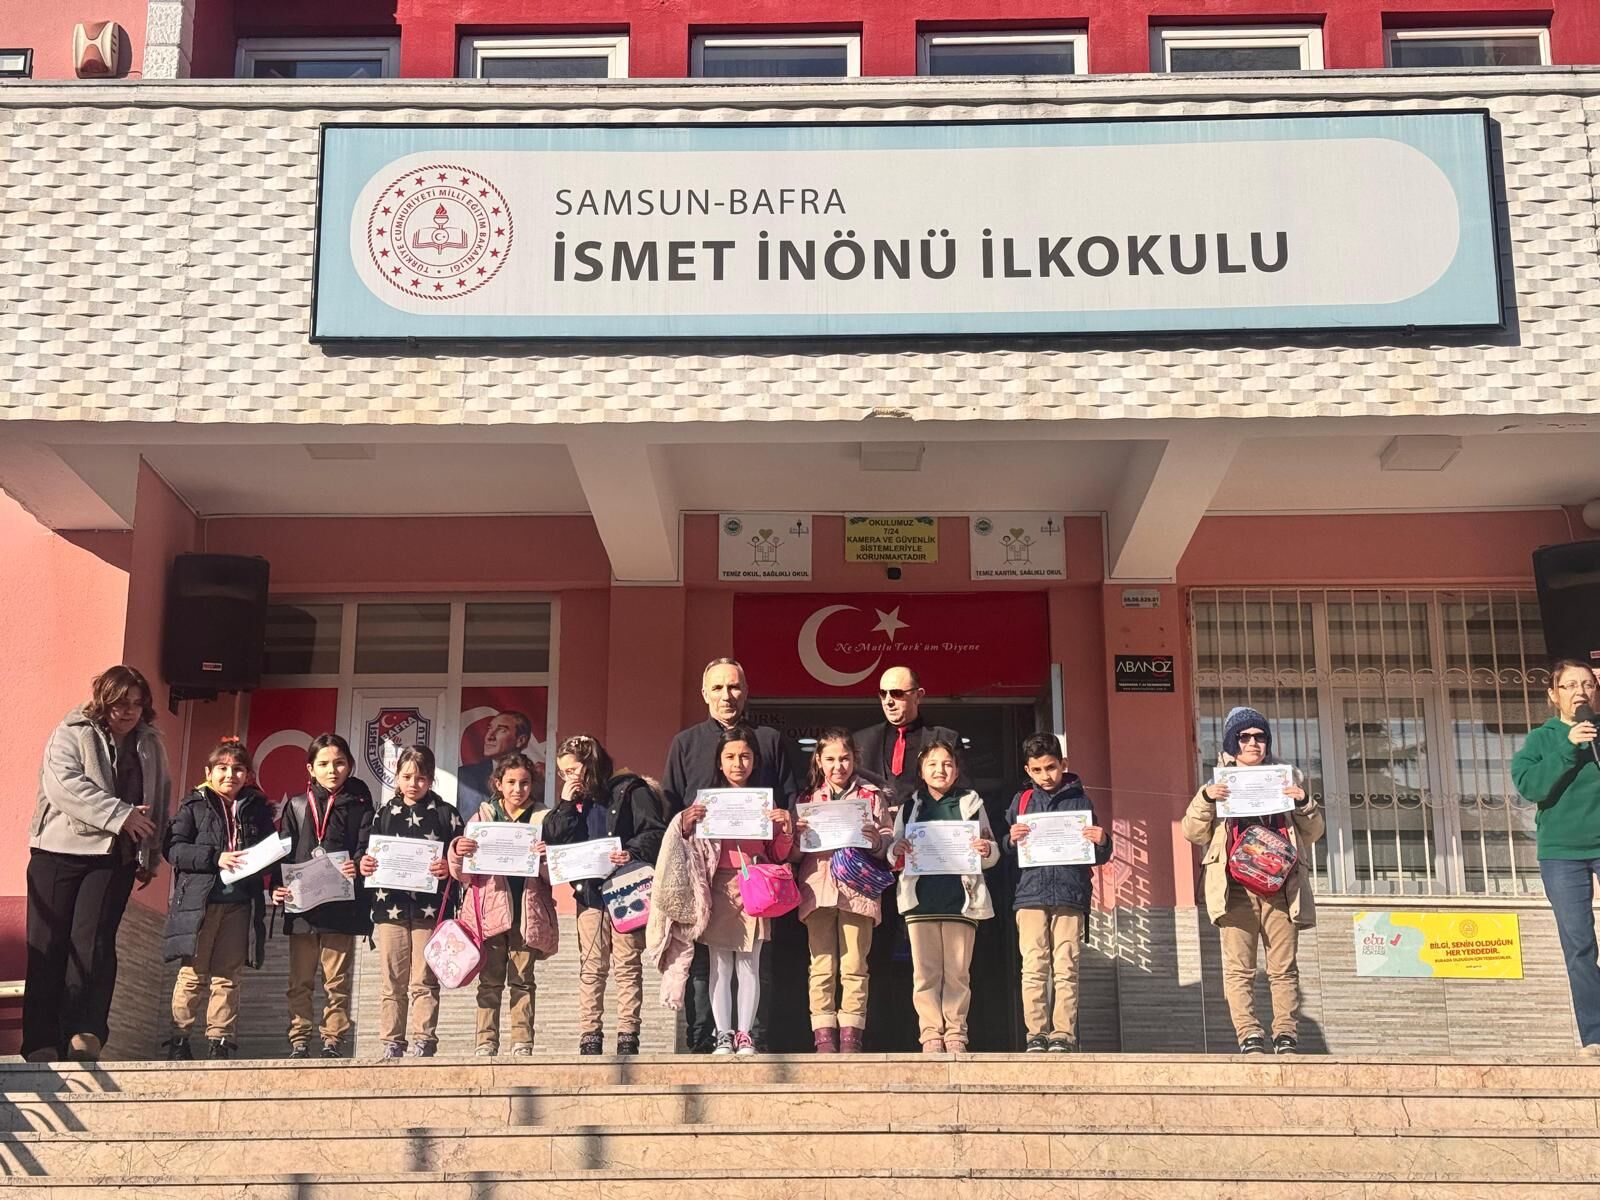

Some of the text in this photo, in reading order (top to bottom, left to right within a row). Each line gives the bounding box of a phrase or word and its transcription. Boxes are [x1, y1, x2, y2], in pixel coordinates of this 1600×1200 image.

[439, 188, 466, 202] MİLLİ
[556, 189, 846, 216] SAMSUN-BAFRA
[394, 189, 436, 241] CUMHURİYETİ
[466, 199, 487, 230] EĞİTİM
[450, 232, 487, 273] BAKANLIĞI
[555, 228, 1288, 282] İSMET İNÖNÜ İLKOKULU
[895, 535, 936, 543] GÜVENLİK
[860, 544, 922, 552] SİSTEMLERİYLE
[834, 642, 852, 654] Ne
[854, 641, 892, 652] Mutlu
[942, 642, 981, 654] Diyene
[1116, 661, 1172, 673] ABANOZ
[380, 716, 417, 742] BAFRA
[1430, 937, 1514, 950] BİLGİ, SENİN OLDUĞUN
[1462, 946, 1500, 956] YERDEDİR.
